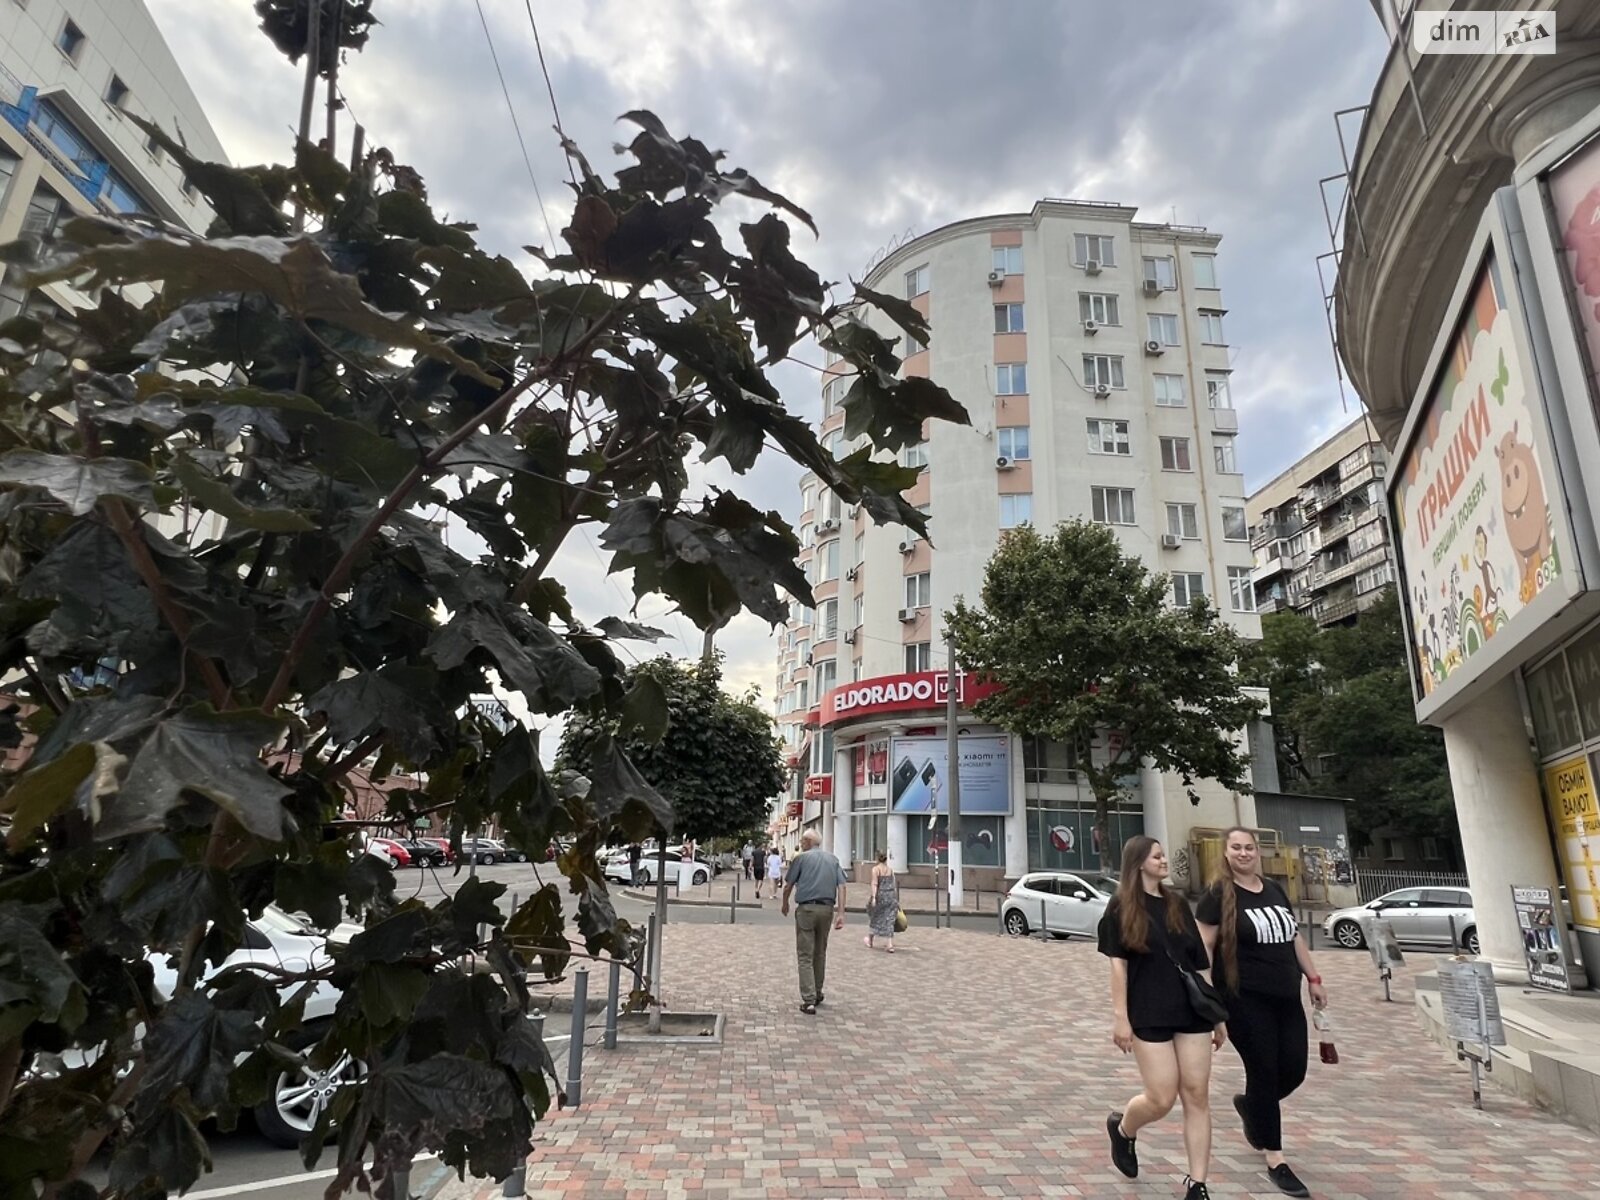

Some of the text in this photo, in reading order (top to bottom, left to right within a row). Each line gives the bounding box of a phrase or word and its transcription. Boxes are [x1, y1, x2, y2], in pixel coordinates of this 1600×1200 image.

[1417, 382, 1491, 548] ІГРАШКИ
[1432, 472, 1487, 568] ПЕРШИЙ ПОВЕРХ
[834, 680, 932, 712] ELDORADO
[1558, 767, 1587, 793] ОБМІН
[1563, 793, 1591, 816] ВАЛЮТ
